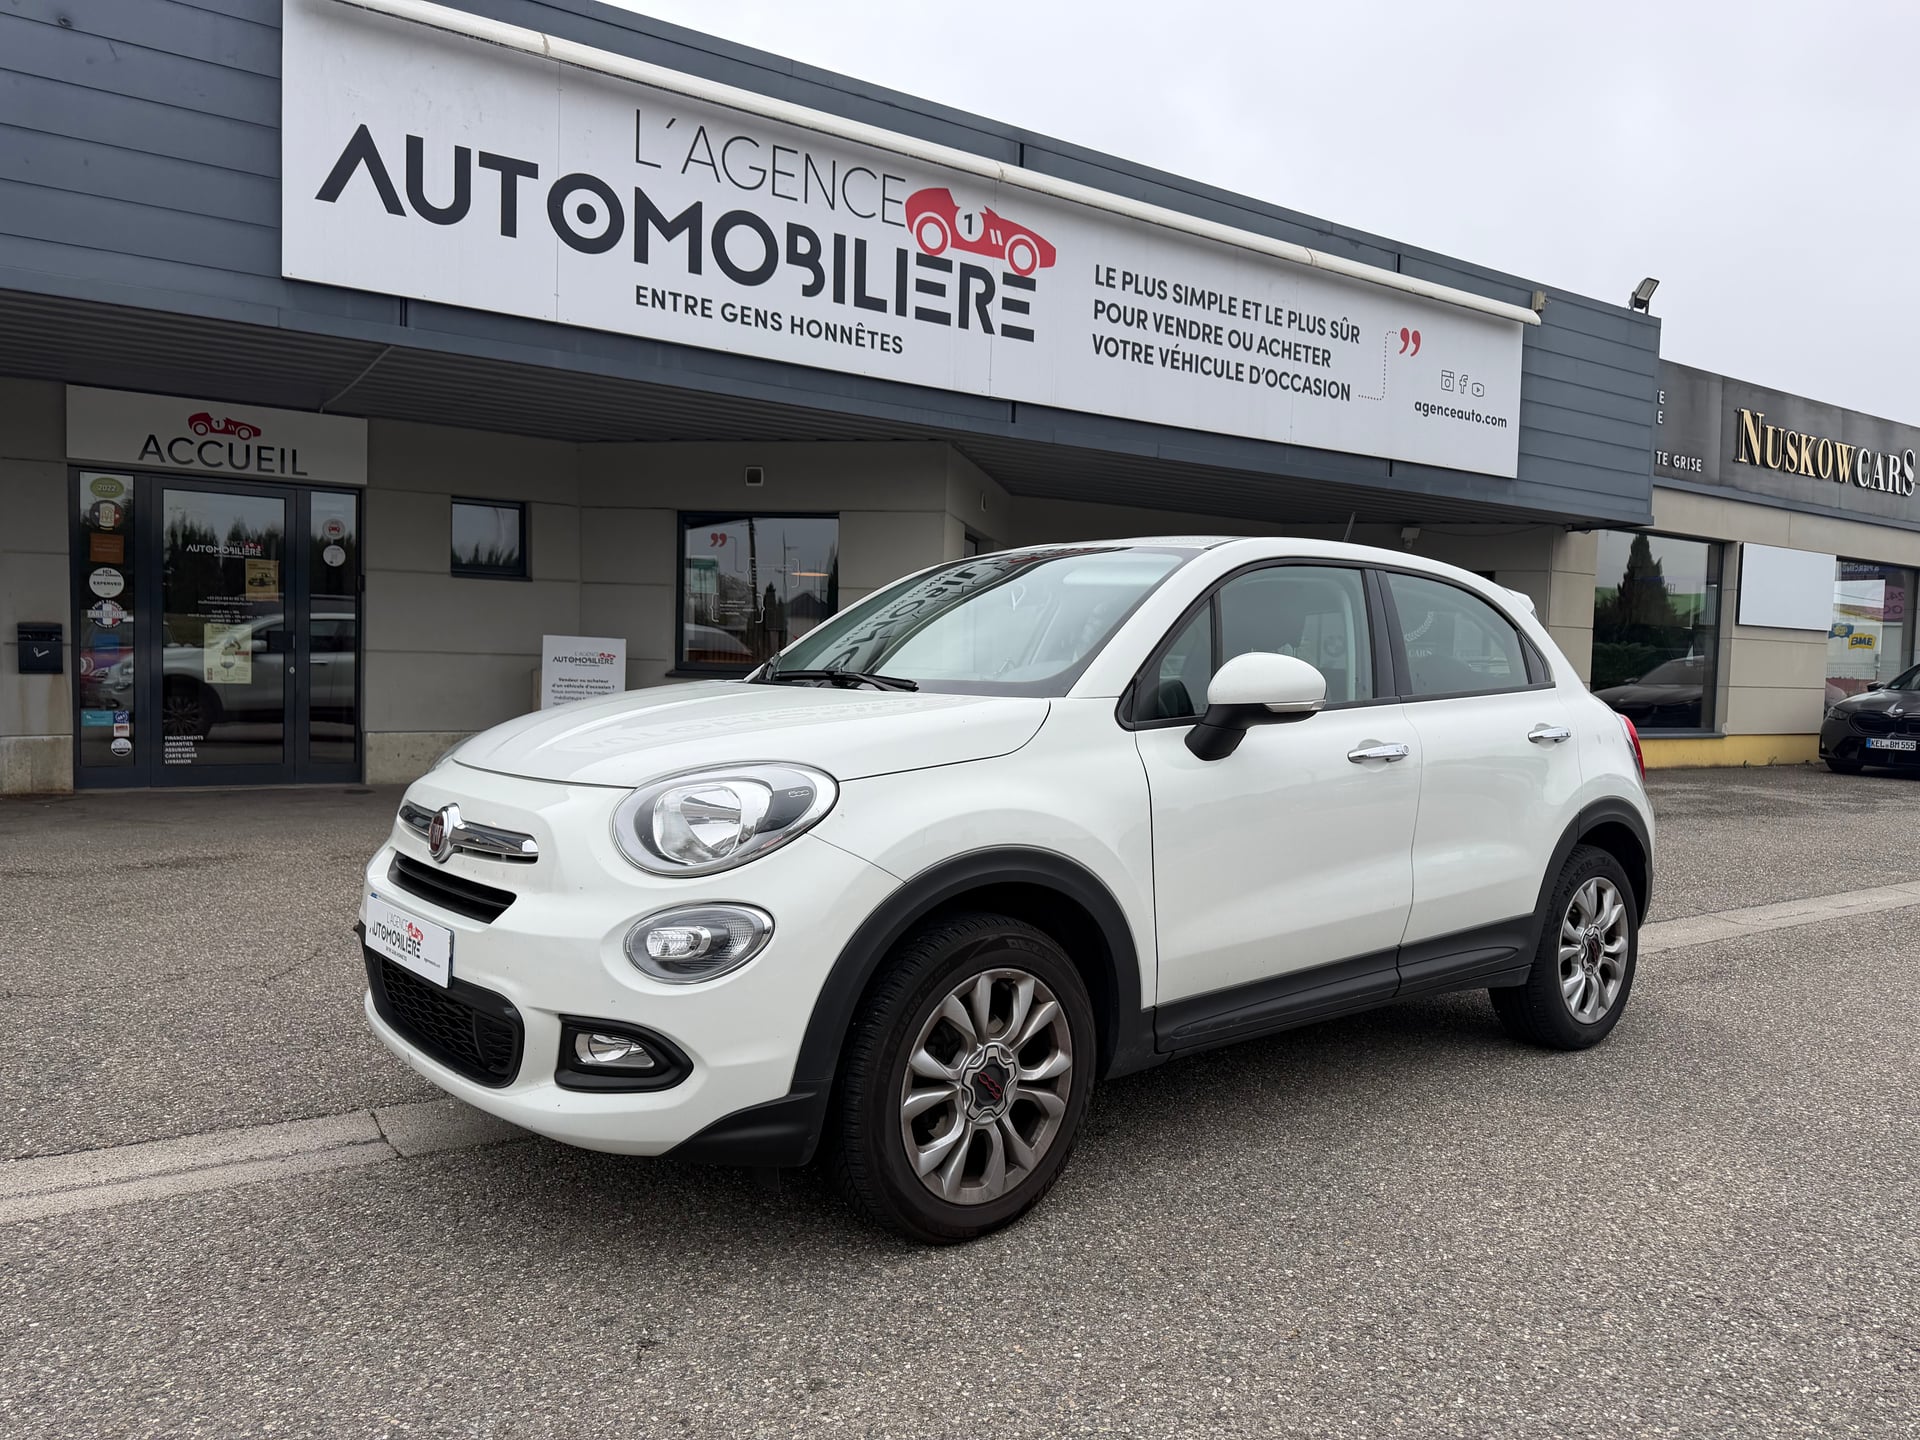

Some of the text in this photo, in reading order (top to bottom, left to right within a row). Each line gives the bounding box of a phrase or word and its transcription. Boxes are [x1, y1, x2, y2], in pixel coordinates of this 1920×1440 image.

[633, 109, 906, 227] L'AGENCE
[964, 213, 973, 235] 1
[636, 284, 904, 354] ENTRE GENS HONNÊTES
[1094, 299, 1331, 368] POUR VENDRE OU ACHETER
[1095, 264, 1360, 344] LE PLUS SIMPLE ET LE PLUS SÛR
[1092, 333, 1350, 401] VOTRE VÉHICULE D'OCCASION
[1414, 401, 1507, 428] agenceauto.com
[138, 434, 308, 476] ACCUEIL
[1673, 454, 1702, 472] GRISE
